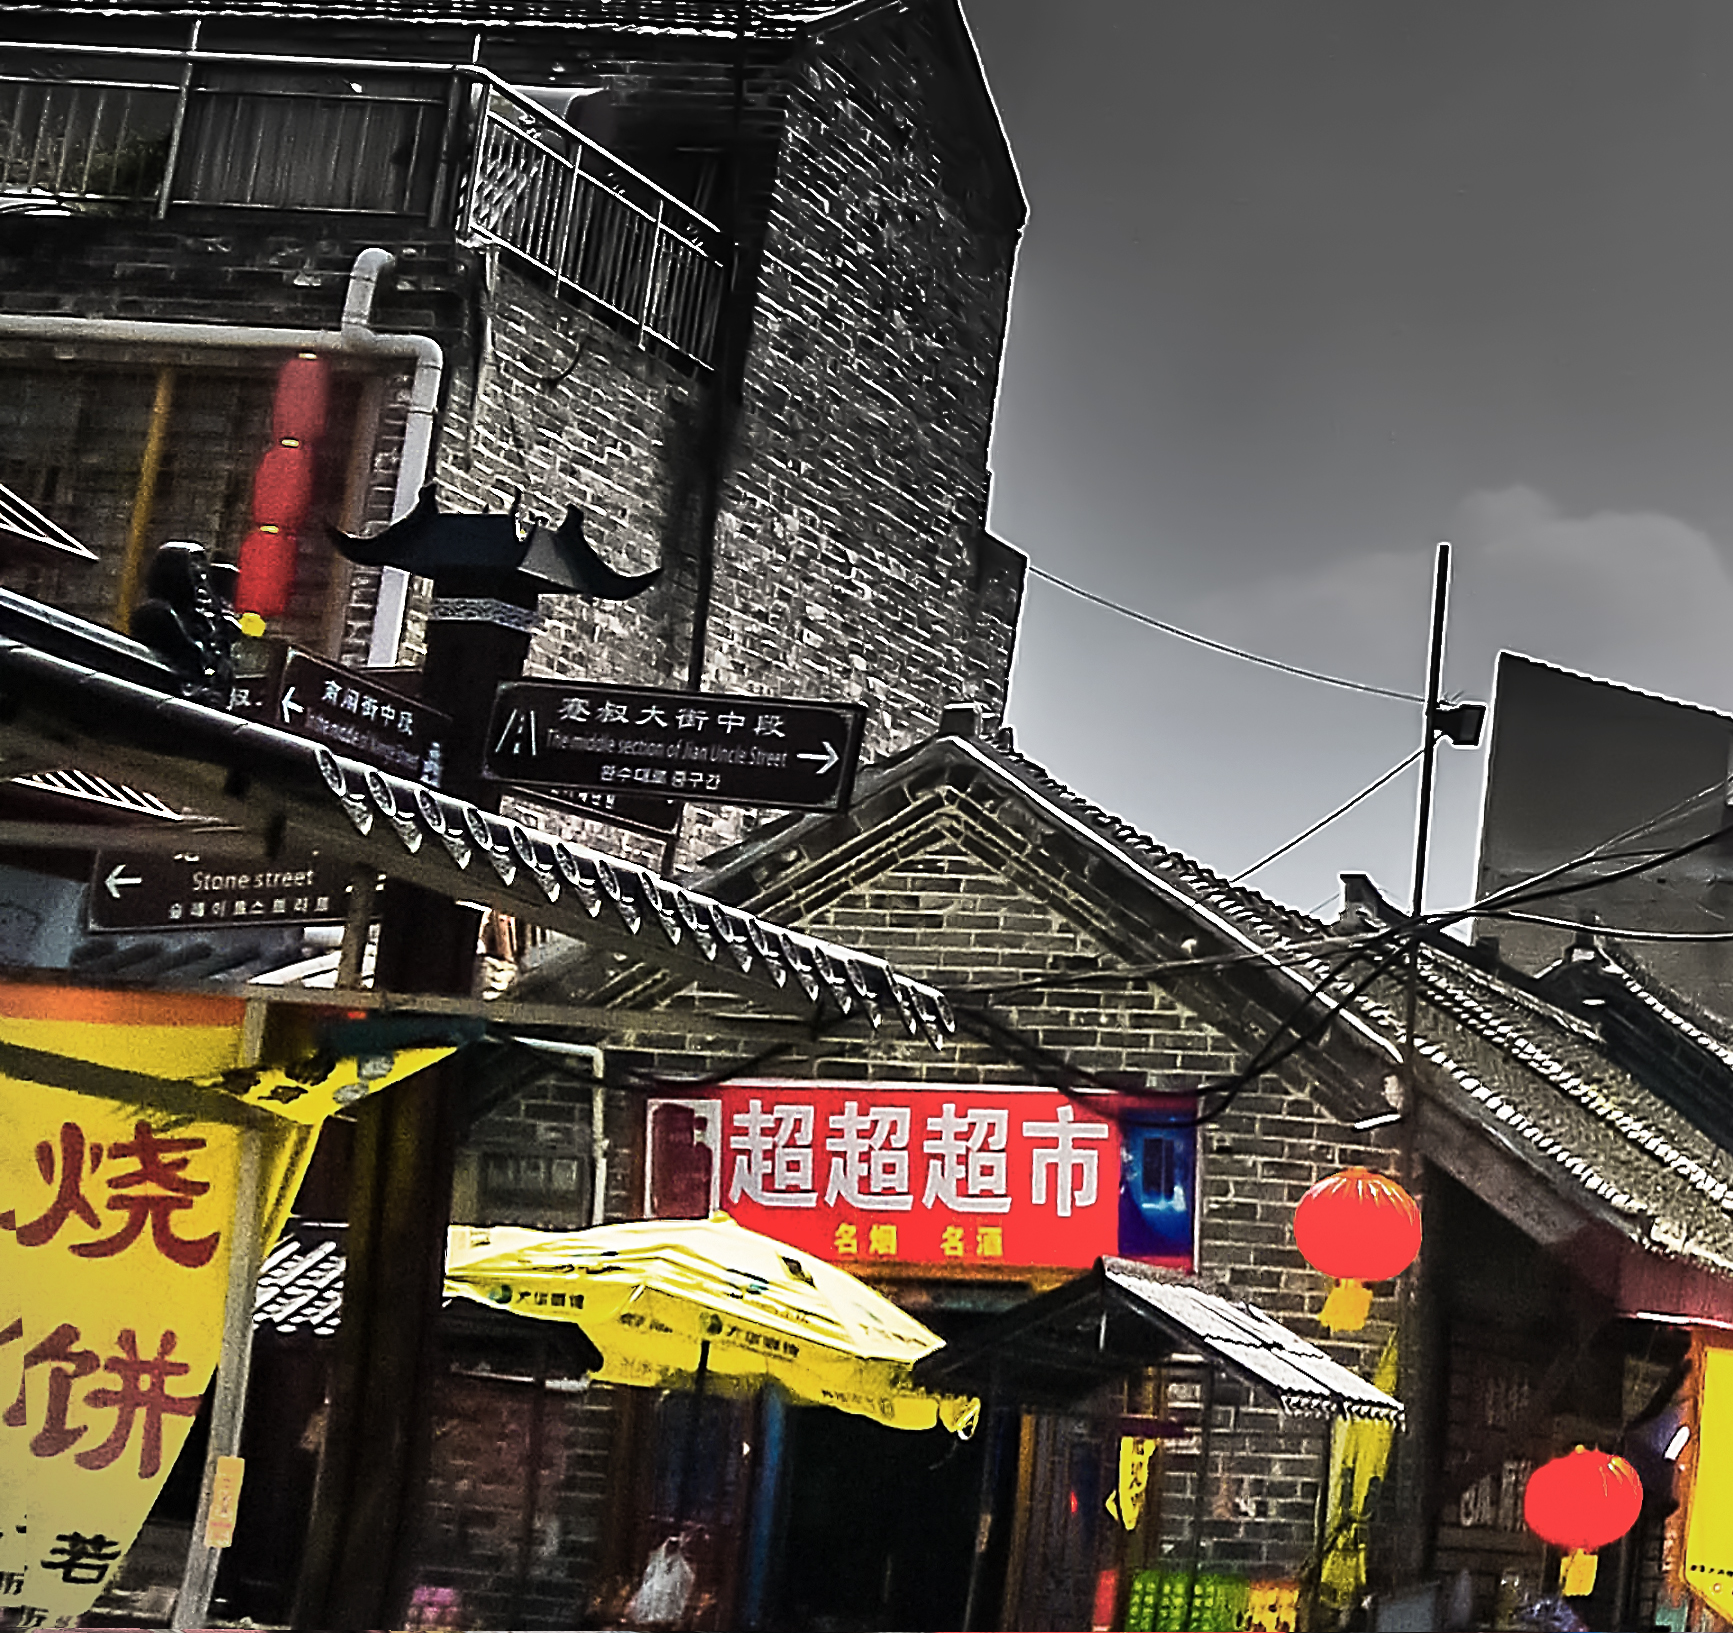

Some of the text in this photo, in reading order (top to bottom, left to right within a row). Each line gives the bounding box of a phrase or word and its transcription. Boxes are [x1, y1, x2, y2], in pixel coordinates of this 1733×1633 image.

[546, 727, 568, 749] The
[572, 733, 616, 754] middle
[618, 737, 664, 758] section
[666, 738, 681, 758] of
[710, 745, 746, 765] Uncle
[749, 746, 788, 767] Street
[192, 869, 315, 891] Stone street
[728, 1099, 1109, 1217] 超超超市
[834, 1223, 1003, 1257] 名烟 名酒
[12, 1119, 221, 1479] 烧饼
